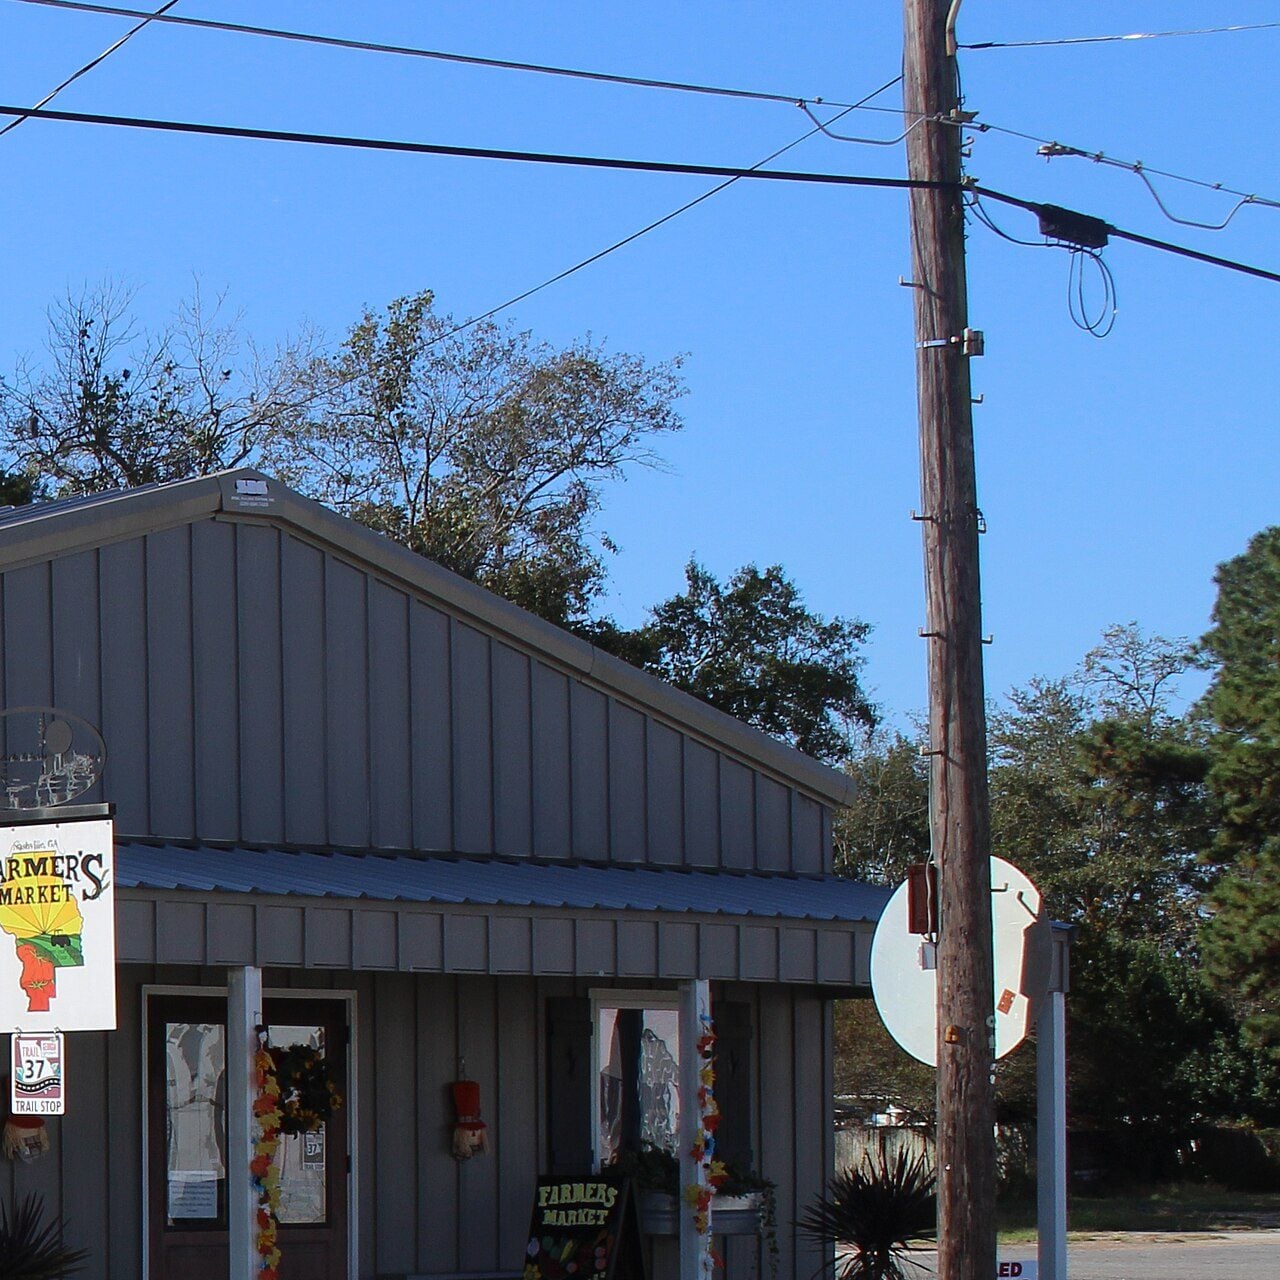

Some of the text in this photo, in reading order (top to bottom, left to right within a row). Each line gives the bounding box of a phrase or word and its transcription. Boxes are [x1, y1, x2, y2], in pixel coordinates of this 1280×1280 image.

[22, 1045, 40, 1058] TRAIL
[25, 1059, 45, 1079] 37
[15, 1100, 62, 1113] TRAIL STOP
[307, 1143, 318, 1154] 37
[538, 1183, 618, 1208] FARMERS
[542, 1208, 609, 1227] MARKET
[996, 1262, 1023, 1277] ED
